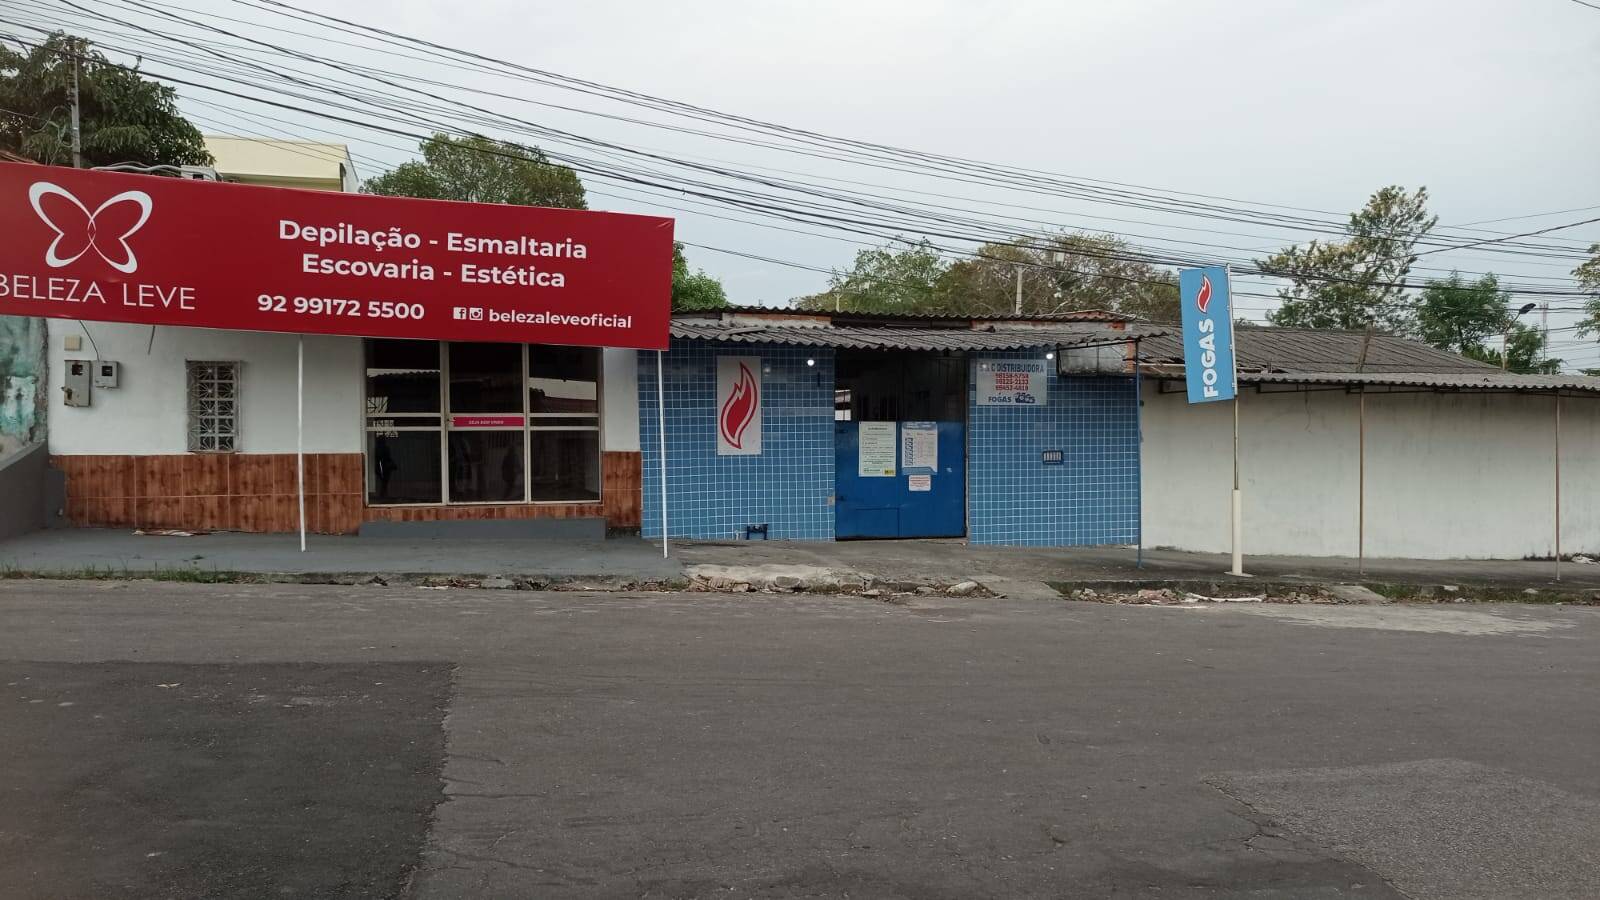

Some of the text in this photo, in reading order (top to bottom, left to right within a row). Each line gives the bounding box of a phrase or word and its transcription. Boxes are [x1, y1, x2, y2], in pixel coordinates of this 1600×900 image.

[279, 219, 421, 253] Depilação
[447, 232, 588, 259] Esmaltaria
[302, 253, 435, 281] Escovaria
[461, 263, 566, 288] Estética
[0, 273, 196, 310] BELEZA LEVE
[257, 294, 426, 321] 92 99172 5500
[488, 307, 633, 329] belezaleveoficial
[1198, 318, 1219, 397] FOGAS
